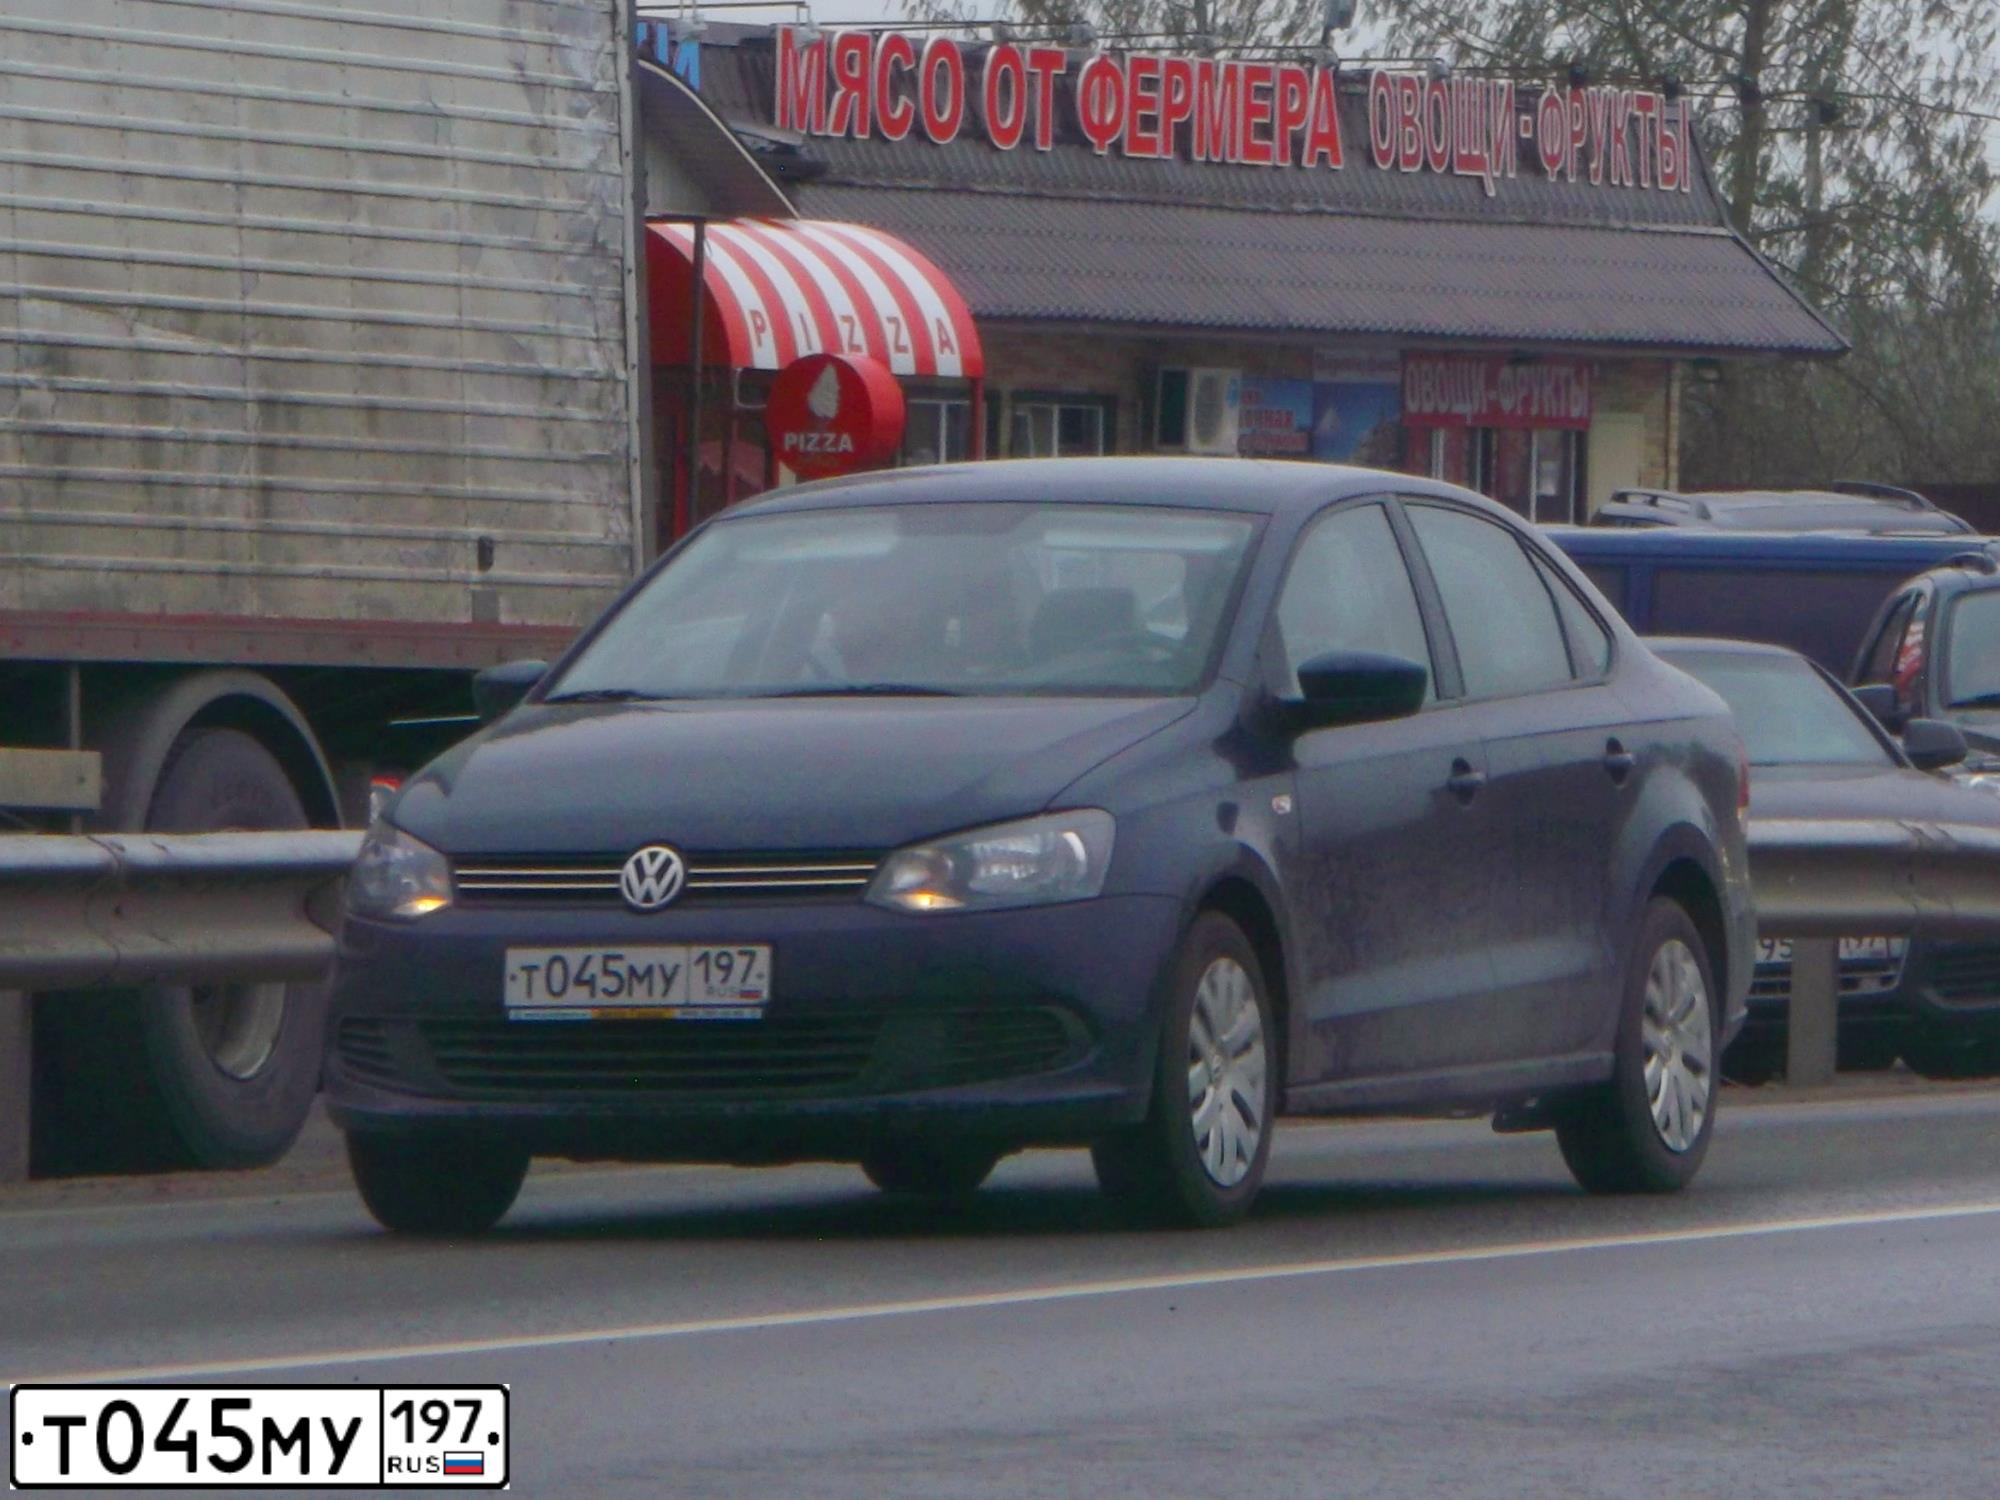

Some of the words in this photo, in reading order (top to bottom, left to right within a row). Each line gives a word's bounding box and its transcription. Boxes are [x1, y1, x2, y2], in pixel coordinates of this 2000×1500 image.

[775, 24, 964, 144] МЯСО
[983, 44, 1066, 151] ОТ
[1077, 54, 1343, 169] ФЕРМЕРА
[749, 309, 956, 355] PIZZA
[783, 431, 854, 453] PIZZA
[694, 949, 757, 984] 197
